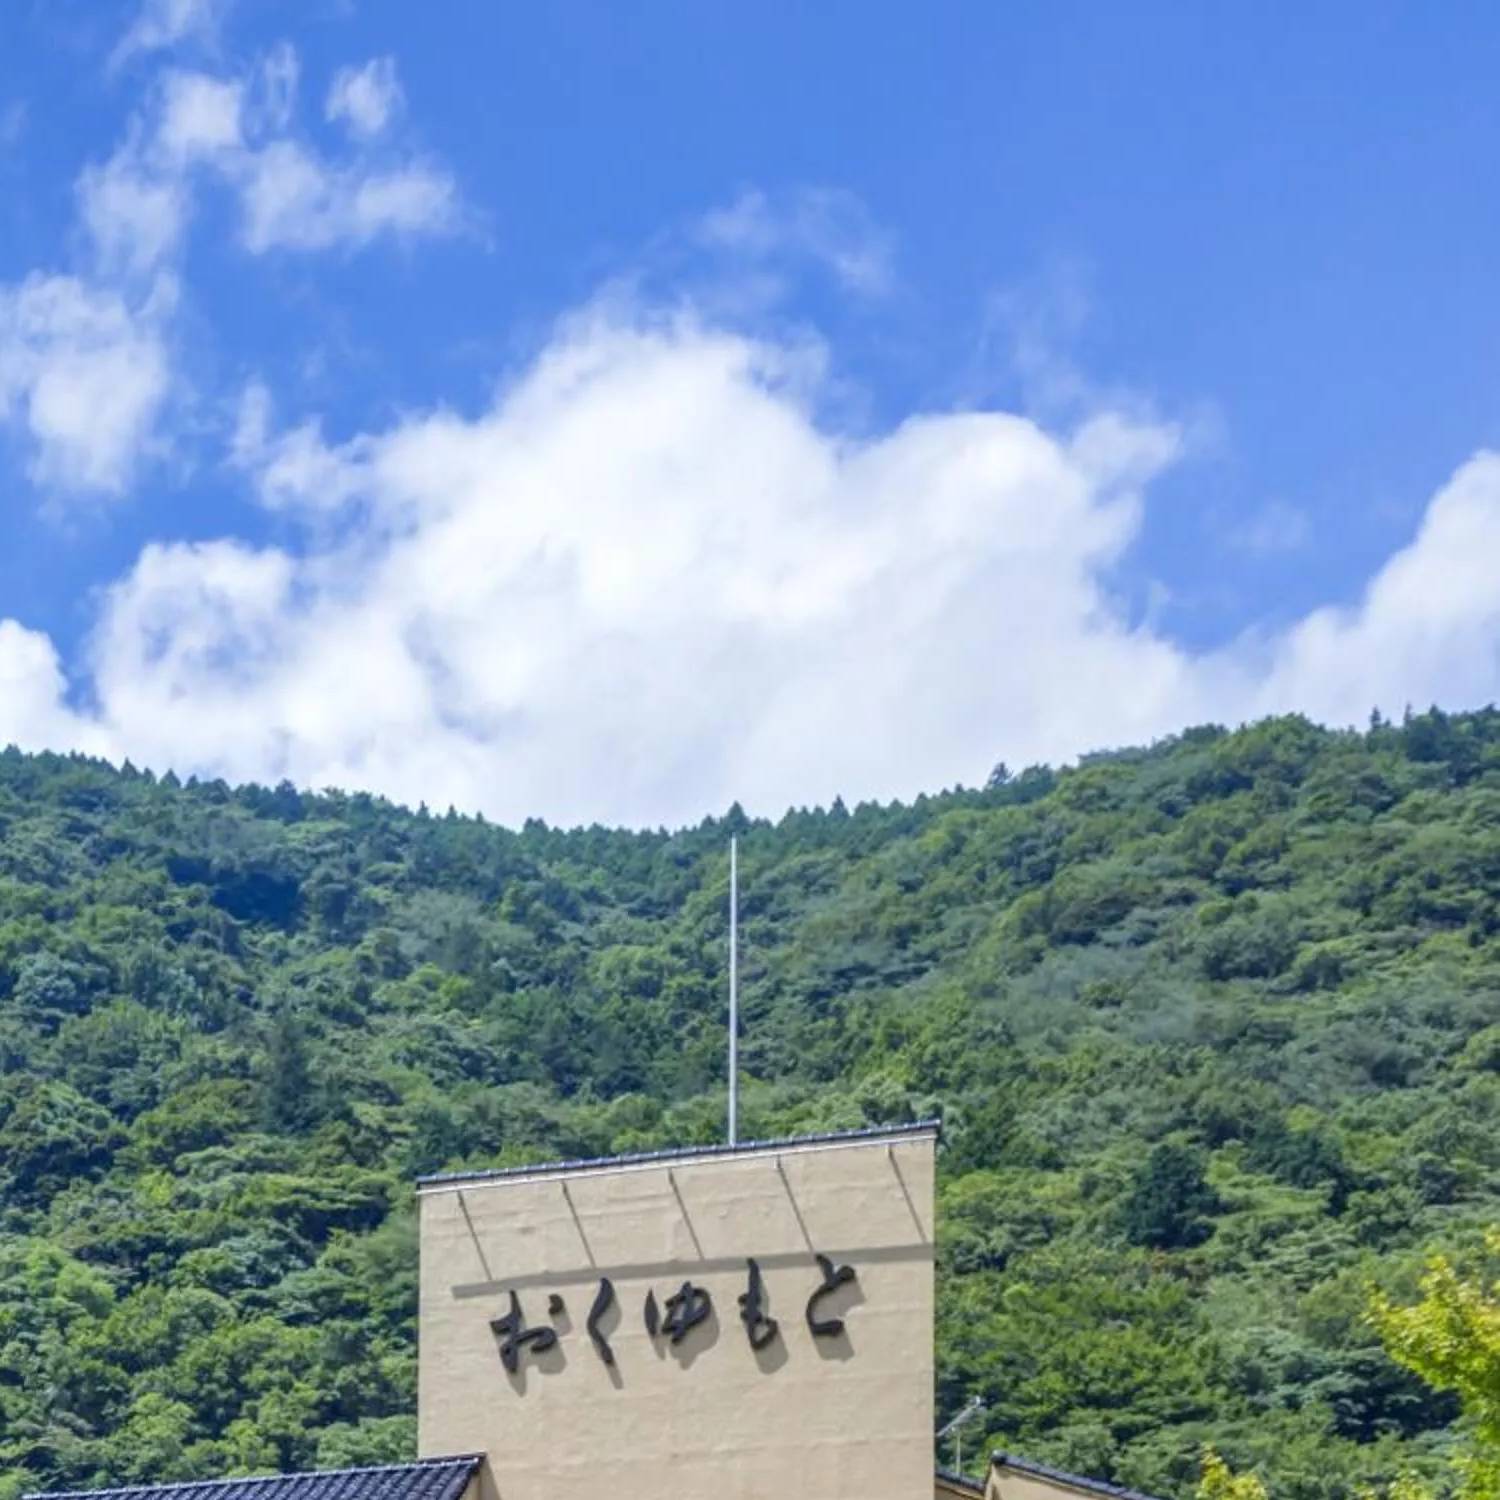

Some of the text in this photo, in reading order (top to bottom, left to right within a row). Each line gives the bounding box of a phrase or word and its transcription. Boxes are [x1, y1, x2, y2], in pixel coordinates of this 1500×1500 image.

[488, 1253, 857, 1374] おくゆもと
